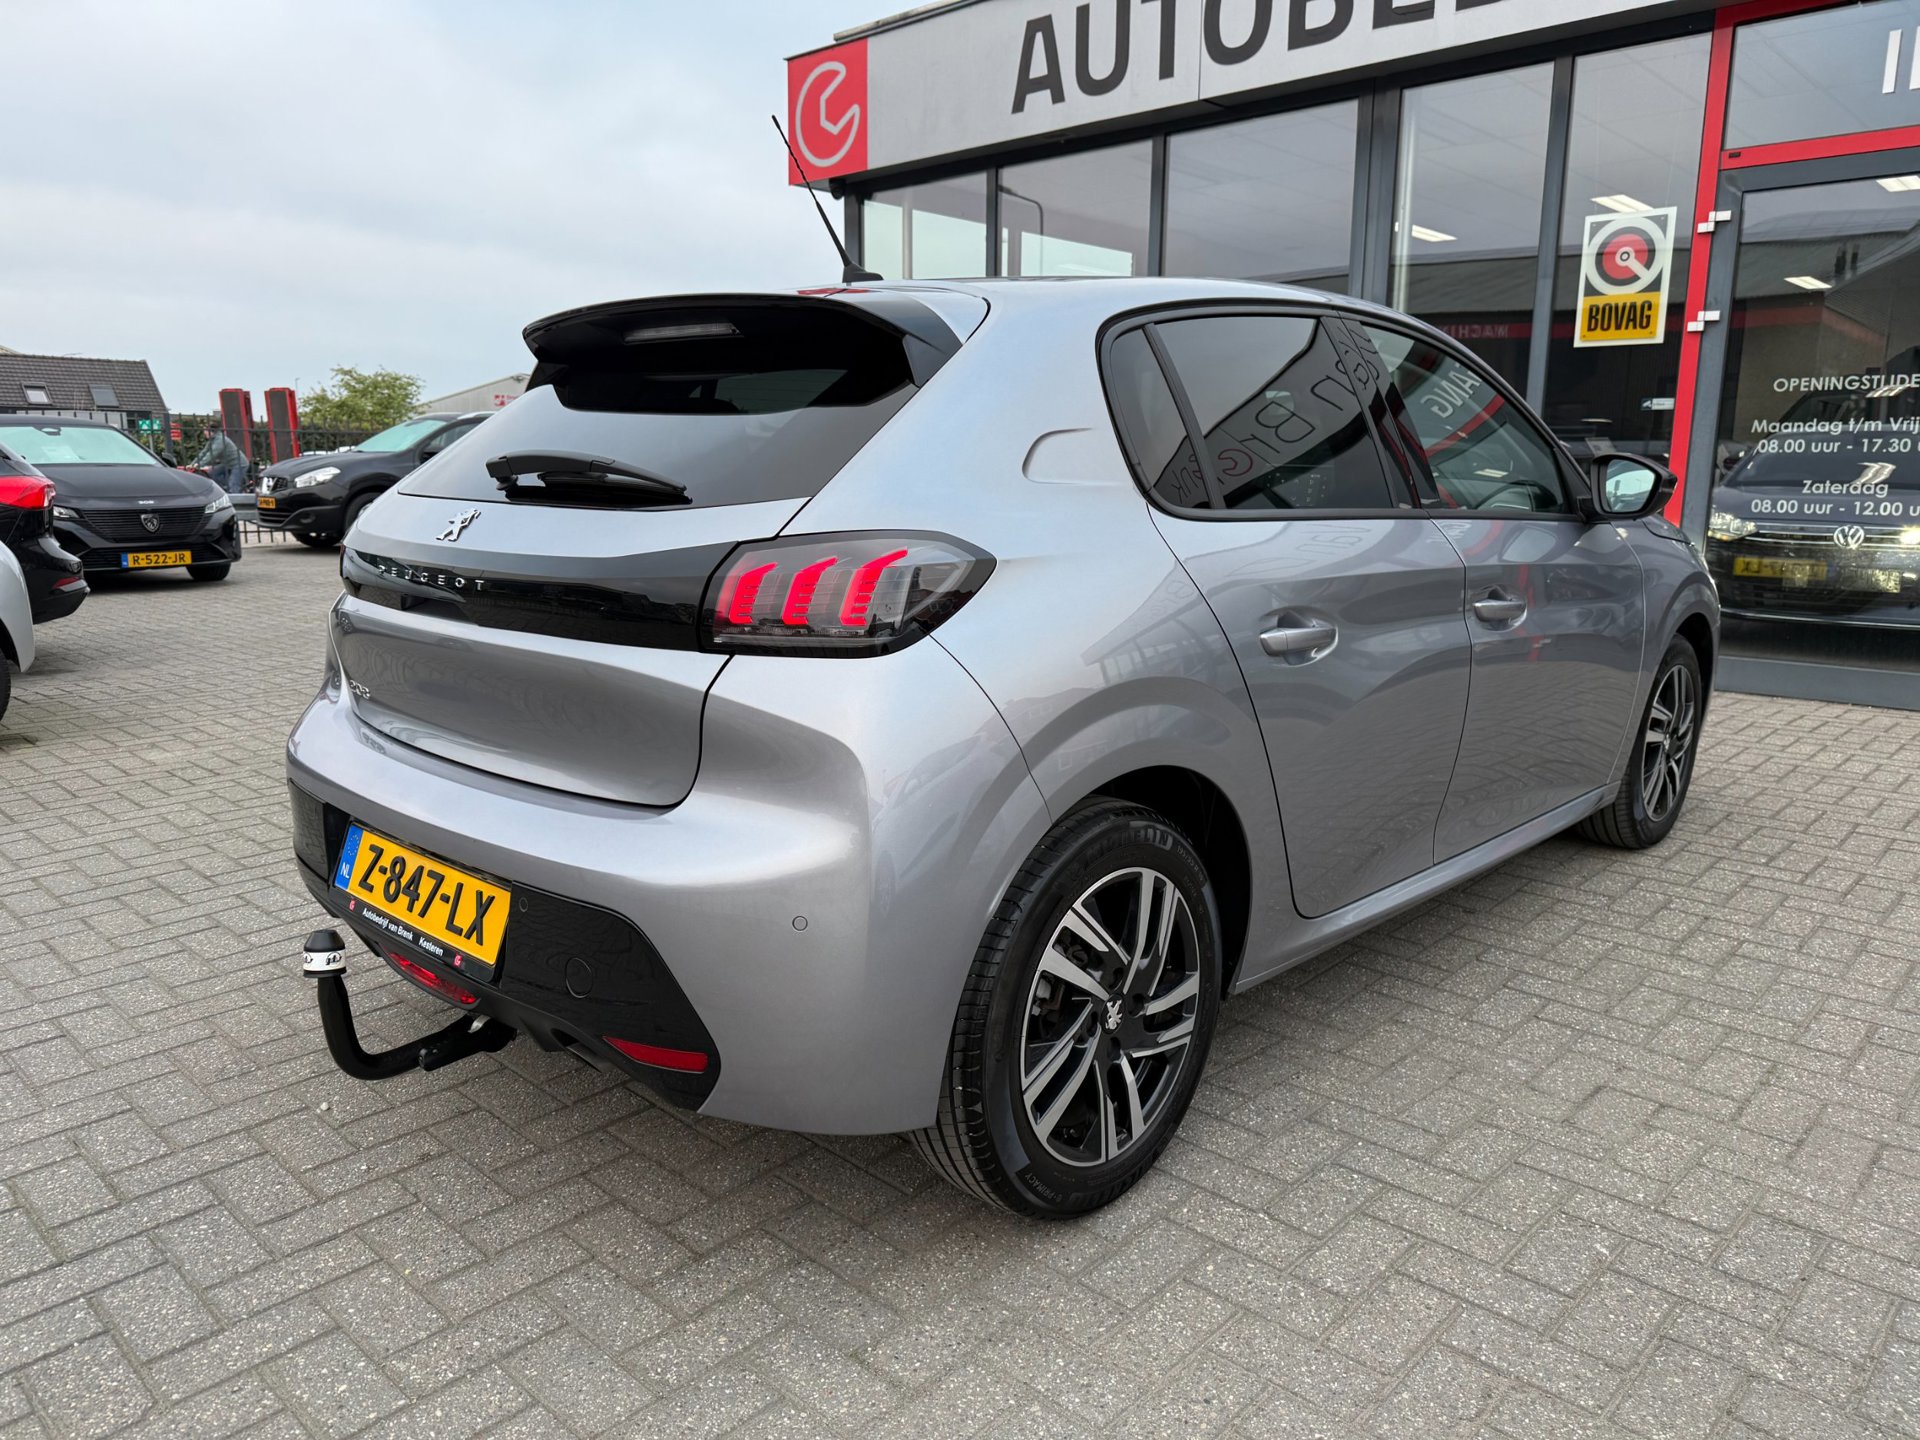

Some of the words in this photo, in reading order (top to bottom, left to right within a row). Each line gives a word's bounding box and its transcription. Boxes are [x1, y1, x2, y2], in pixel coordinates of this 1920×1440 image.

[1012, 0, 1509, 114] AUTO
[1587, 300, 1653, 332] BOVAG
[1751, 418, 1842, 436] Maandag
[1849, 417, 1882, 433] t/m
[1758, 439, 1806, 453] 08.00
[1811, 441, 1841, 453] uur
[1862, 438, 1911, 453] 17.30
[1802, 480, 1889, 498] Zaterdag
[1751, 499, 1798, 513] 08.00
[1804, 503, 1833, 514] uur
[1854, 501, 1903, 516] 12.00
[132, 552, 187, 566] R-522-JR
[378, 564, 485, 592] PEUGEOT
[340, 862, 350, 879] NL
[358, 844, 496, 946] Z-847-LX
[362, 907, 389, 929] Autobedrijf
[388, 921, 398, 933] van
[397, 925, 414, 941] Brenk
[418, 937, 444, 957] Kesteren
